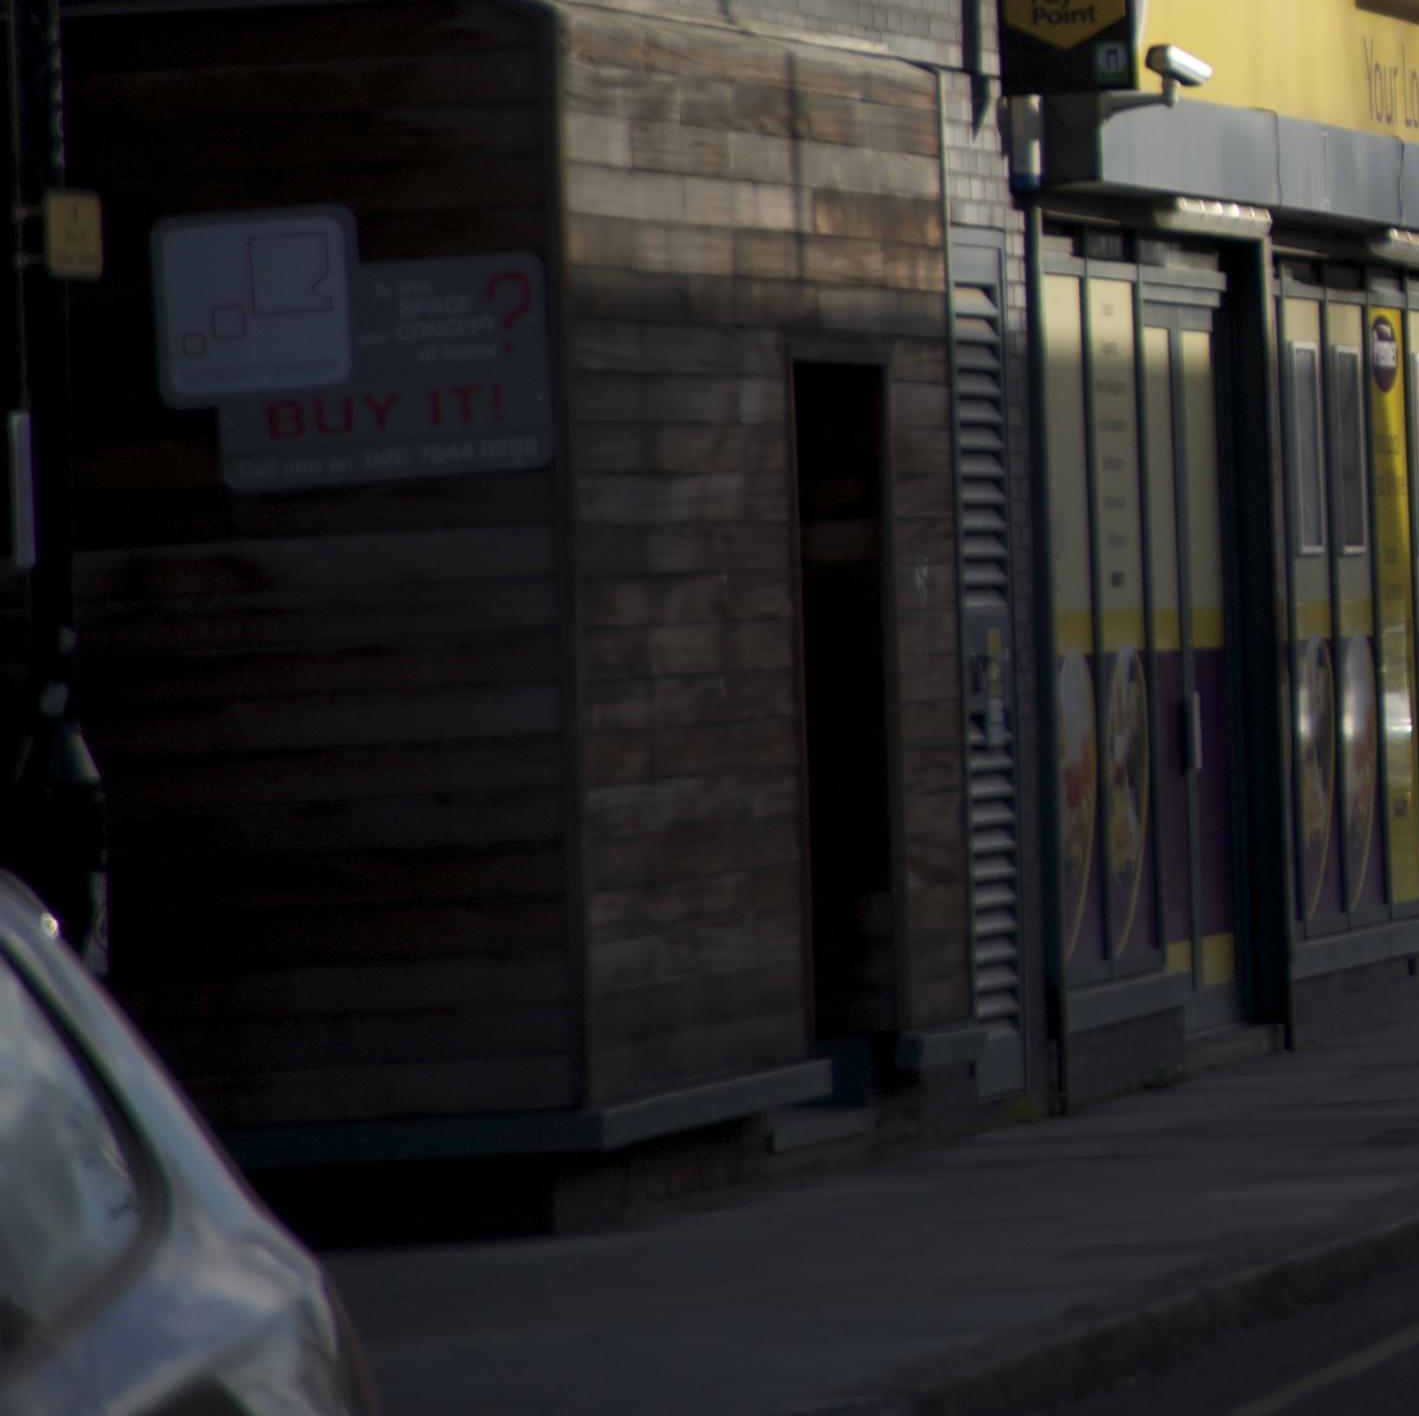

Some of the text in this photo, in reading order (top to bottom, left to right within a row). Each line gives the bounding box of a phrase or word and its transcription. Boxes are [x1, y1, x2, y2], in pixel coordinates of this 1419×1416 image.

[1032, 6, 1097, 25] Point
[1362, 35, 1398, 125] Your
[396, 277, 433, 295] this
[399, 293, 472, 318] SPACE
[356, 317, 497, 348] your CONCEPT
[417, 341, 499, 363] of home
[267, 382, 505, 441] BUY IT!
[239, 457, 277, 480] Call
[284, 457, 324, 476] now
[329, 456, 354, 472] on
[365, 448, 410, 469] 020
[420, 443, 474, 463] 7644
